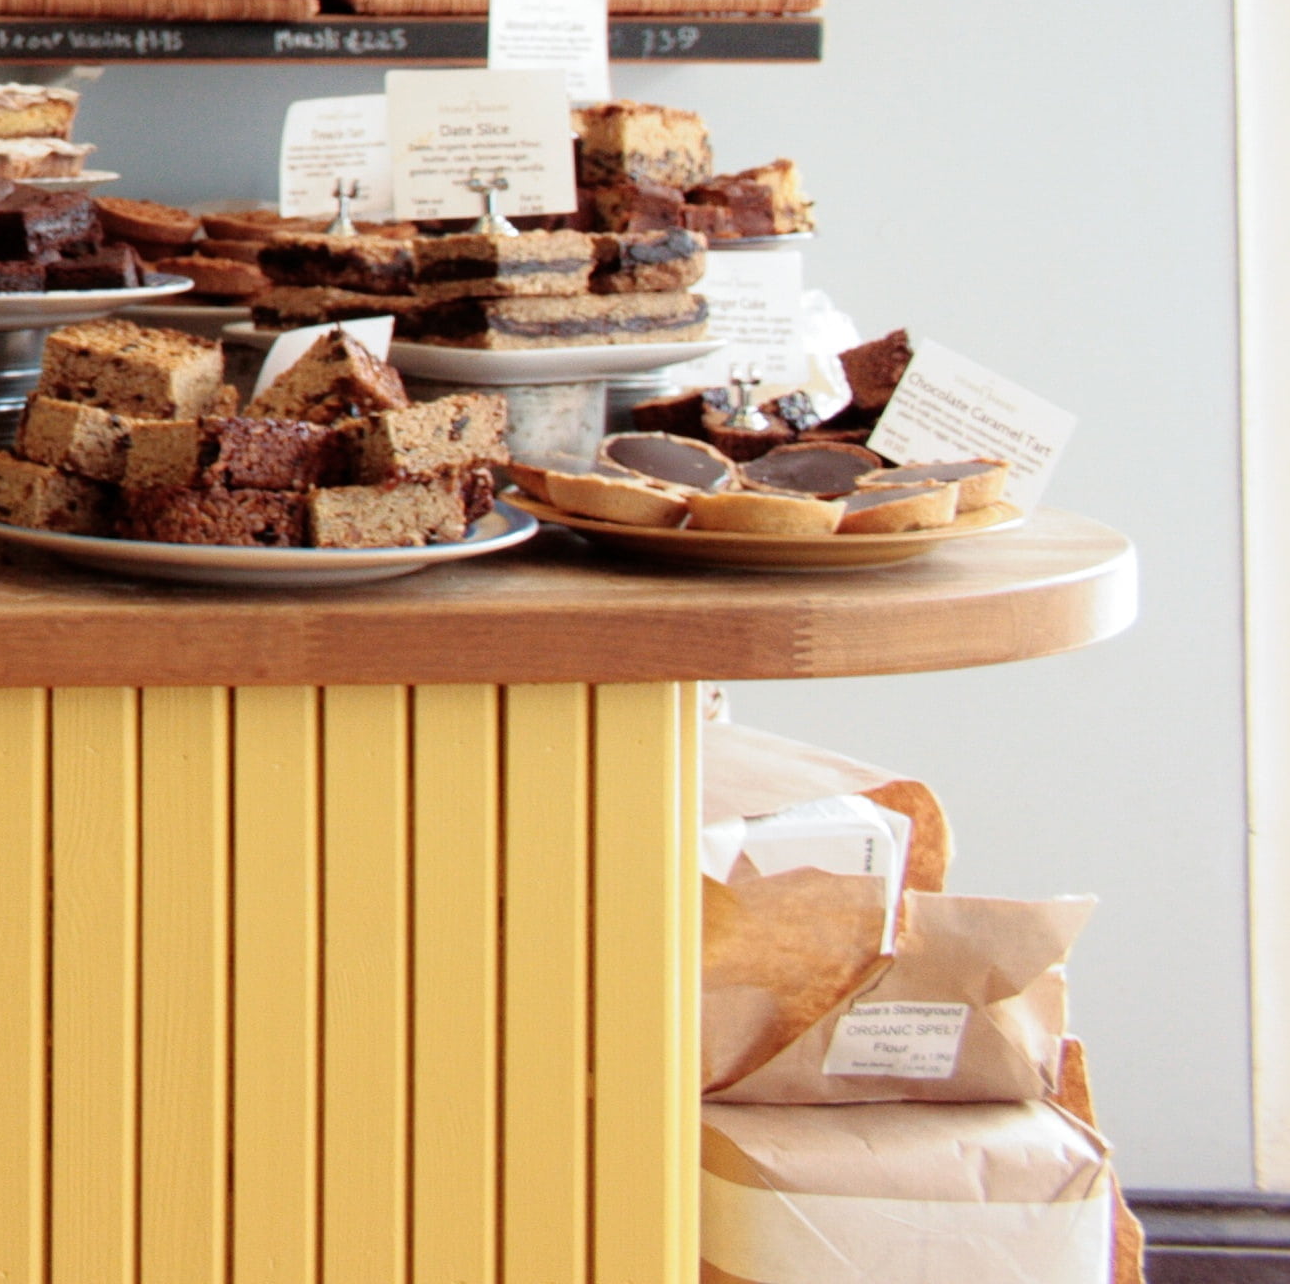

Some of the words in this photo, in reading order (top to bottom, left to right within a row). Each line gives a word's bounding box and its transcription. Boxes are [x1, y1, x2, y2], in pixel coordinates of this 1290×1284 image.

[439, 123, 472, 137] Date
[477, 122, 509, 136] Slice
[906, 371, 970, 415] Chocolate
[969, 405, 1023, 444] Caramel
[1024, 432, 1054, 459] Tart
[892, 1002, 964, 1018] Stoneground
[846, 1022, 913, 1037] ORGANIC
[917, 1022, 962, 1036] SPELT
[872, 1041, 909, 1054] Flour
